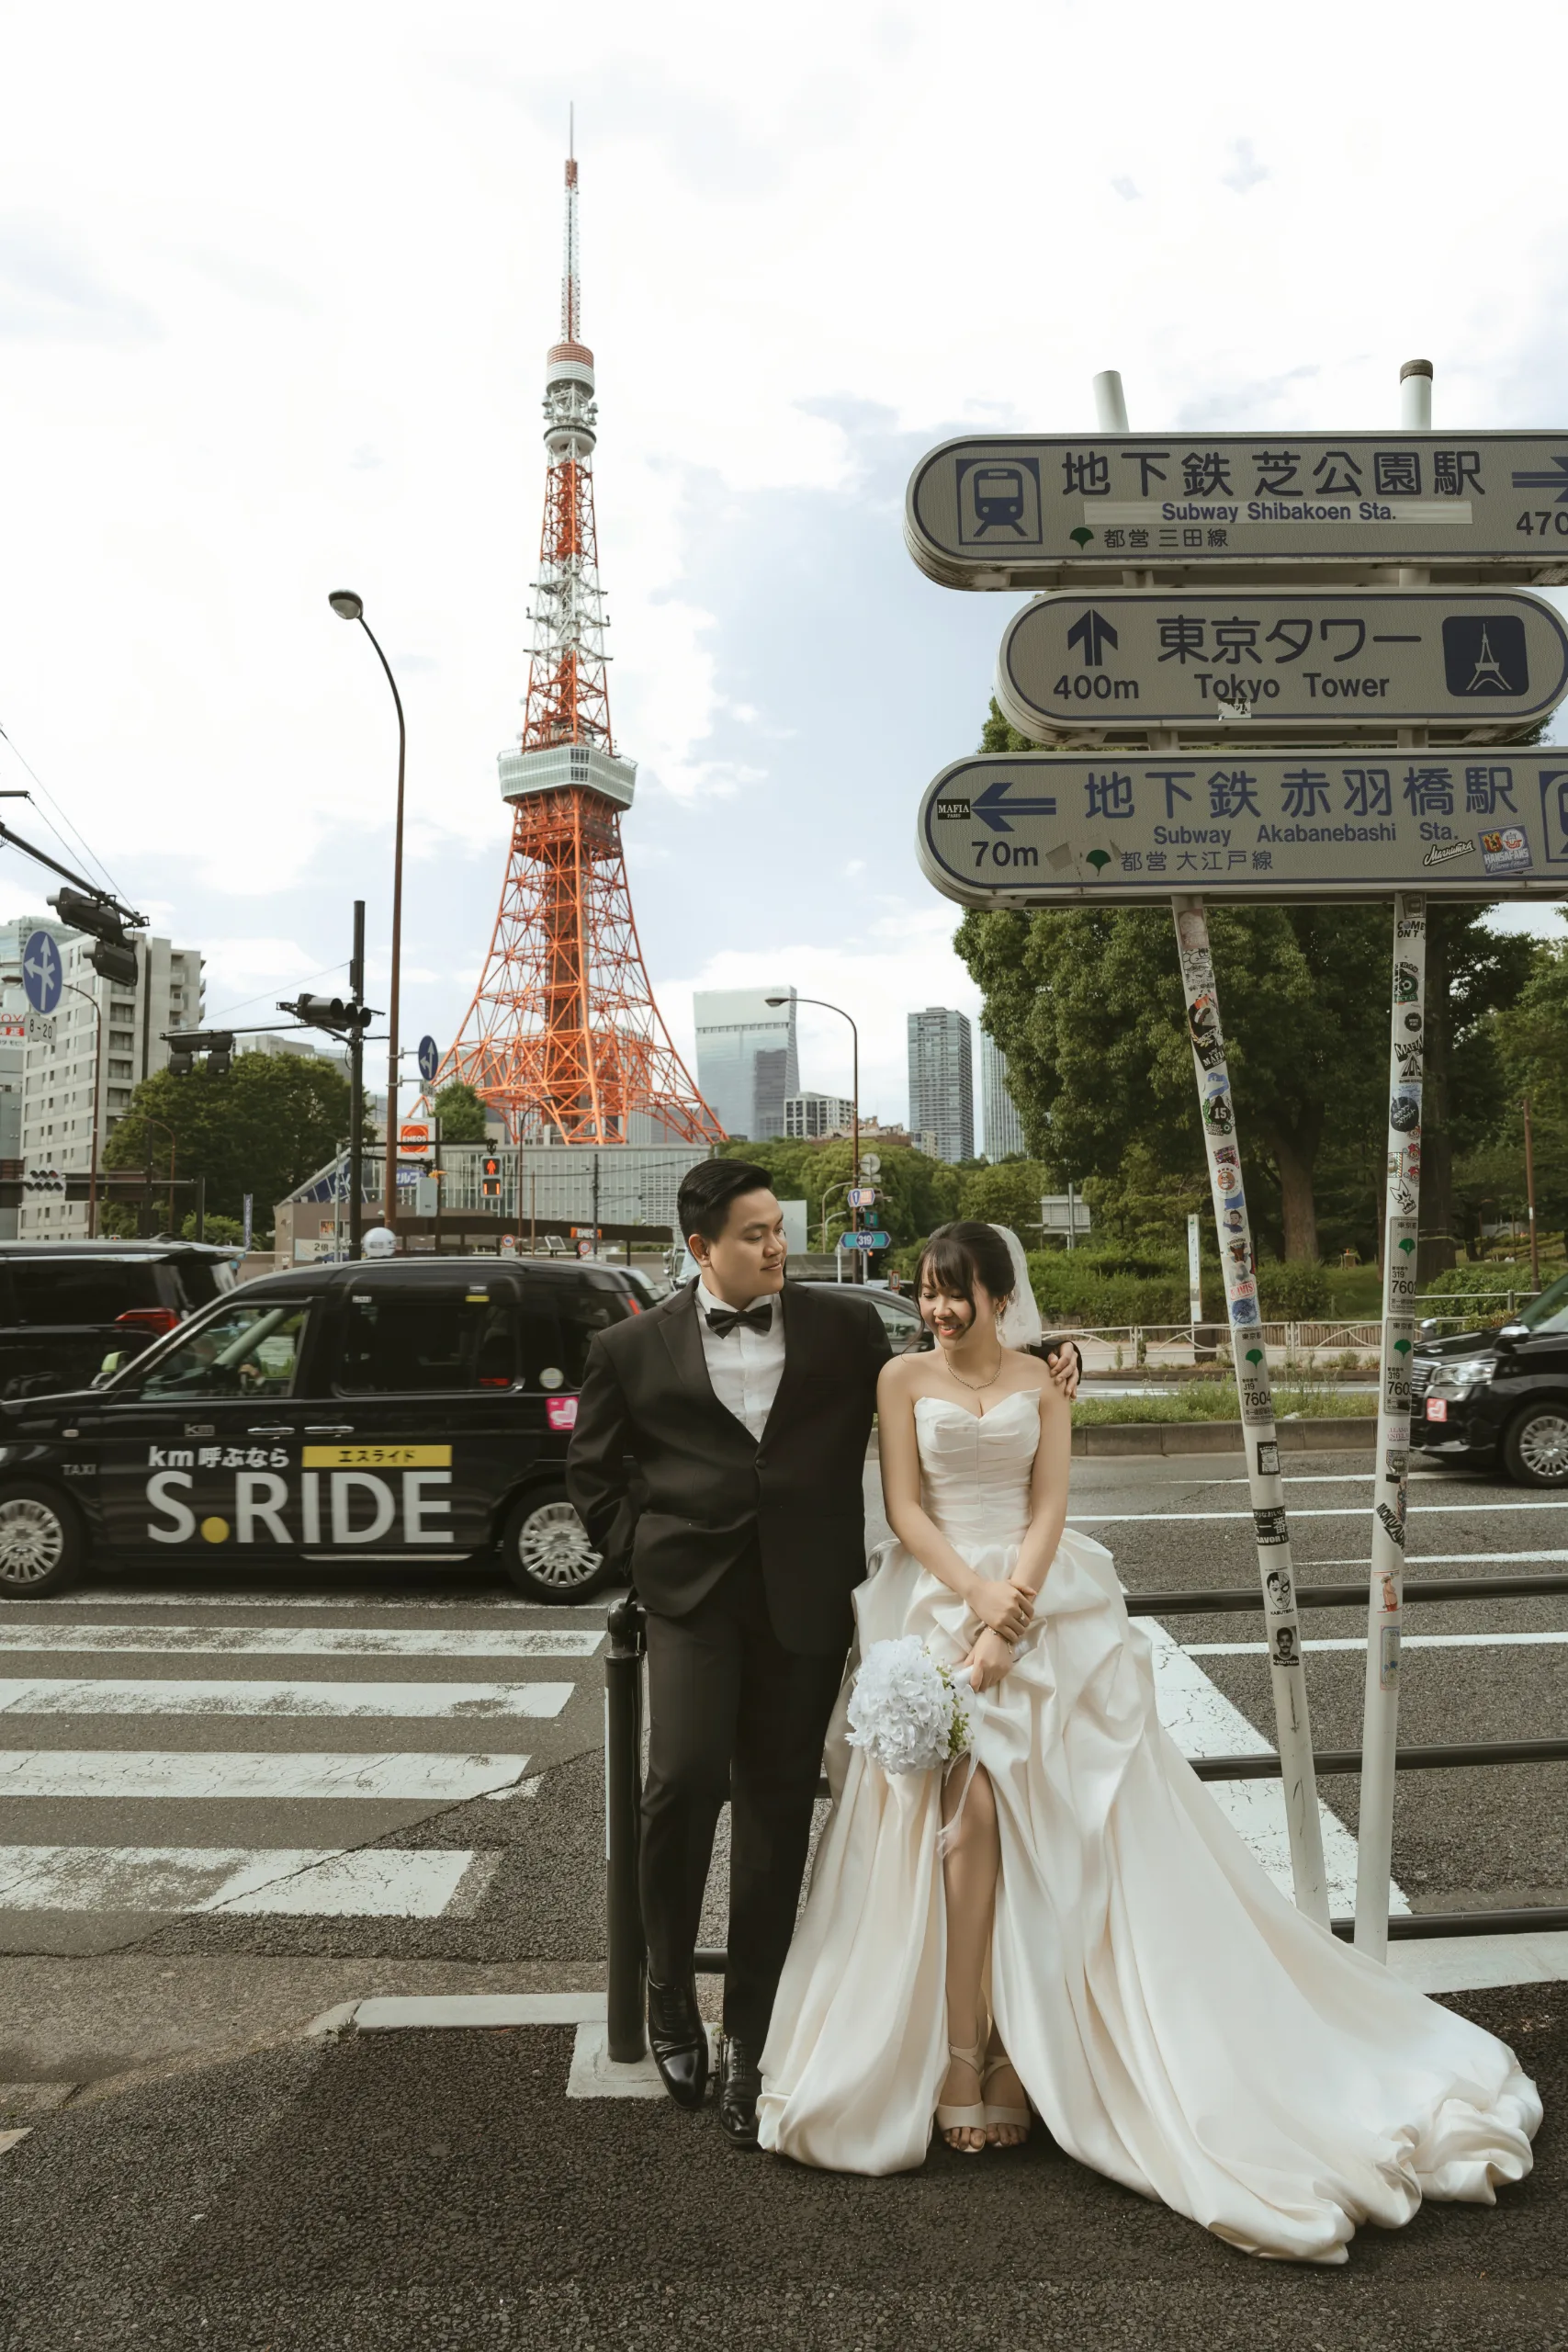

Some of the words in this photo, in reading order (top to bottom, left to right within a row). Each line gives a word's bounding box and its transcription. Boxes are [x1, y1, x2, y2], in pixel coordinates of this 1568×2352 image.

[1062, 451, 1234, 497] 地下鉄
[1254, 451, 1485, 496] 芝公園駅
[1163, 503, 1238, 522] Subway
[1247, 503, 1350, 521] Shibakoen
[1359, 503, 1396, 521] Sta.
[1517, 512, 1568, 535] 470
[1104, 529, 1148, 548] 都営
[1159, 528, 1228, 547] 三田線
[1156, 615, 1421, 664] 東京タワー
[1054, 675, 1138, 699] 400m
[1194, 673, 1280, 700] Tokyo
[1303, 673, 1389, 697] Tower
[1084, 771, 1261, 819] 地下鉄
[1280, 767, 1517, 818] 赤羽橋駅
[938, 804, 969, 813] MAFIA
[1154, 826, 1231, 847] Subway
[1257, 824, 1396, 843] Akabanebashi
[1420, 822, 1460, 842] Sta.
[972, 842, 1038, 866] 70m
[1121, 851, 1167, 871] 都営
[1177, 850, 1272, 871] 大江戸線
[1483, 846, 1530, 868] HANSAFANS
[30, 1019, 52, 1039] 8-20
[1214, 1108, 1227, 1119] 15
[858, 1236, 872, 1246] 319
[339, 1449, 414, 1463] エスライド
[62, 1464, 96, 1475] TAXI
[147, 1471, 454, 1543] S.RIDE
